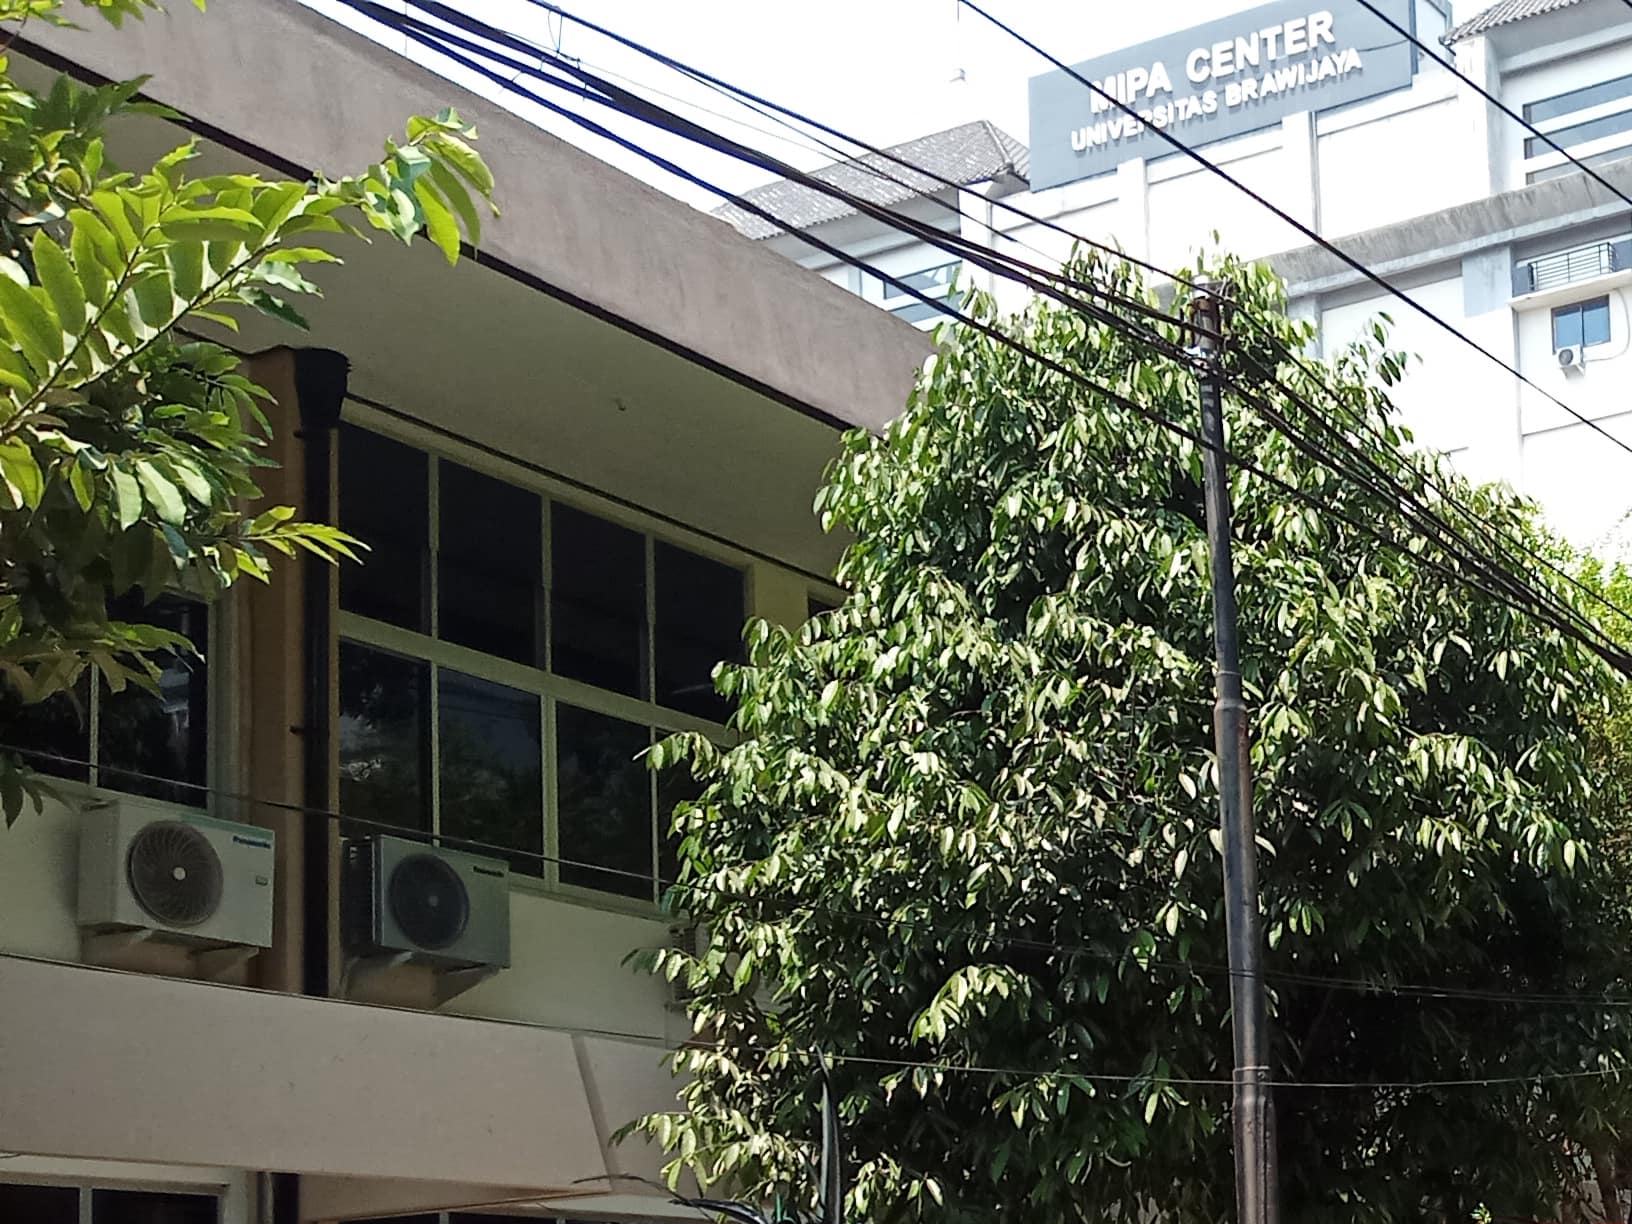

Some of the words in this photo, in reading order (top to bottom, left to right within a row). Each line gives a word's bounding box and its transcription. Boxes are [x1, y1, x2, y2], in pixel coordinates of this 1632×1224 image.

[1071, 90, 1218, 151] UNIVERSITAS
[1226, 48, 1364, 108] BRAWIJAYA
[1090, 61, 1173, 114] MIPA
[1186, 11, 1336, 83] CENTER
